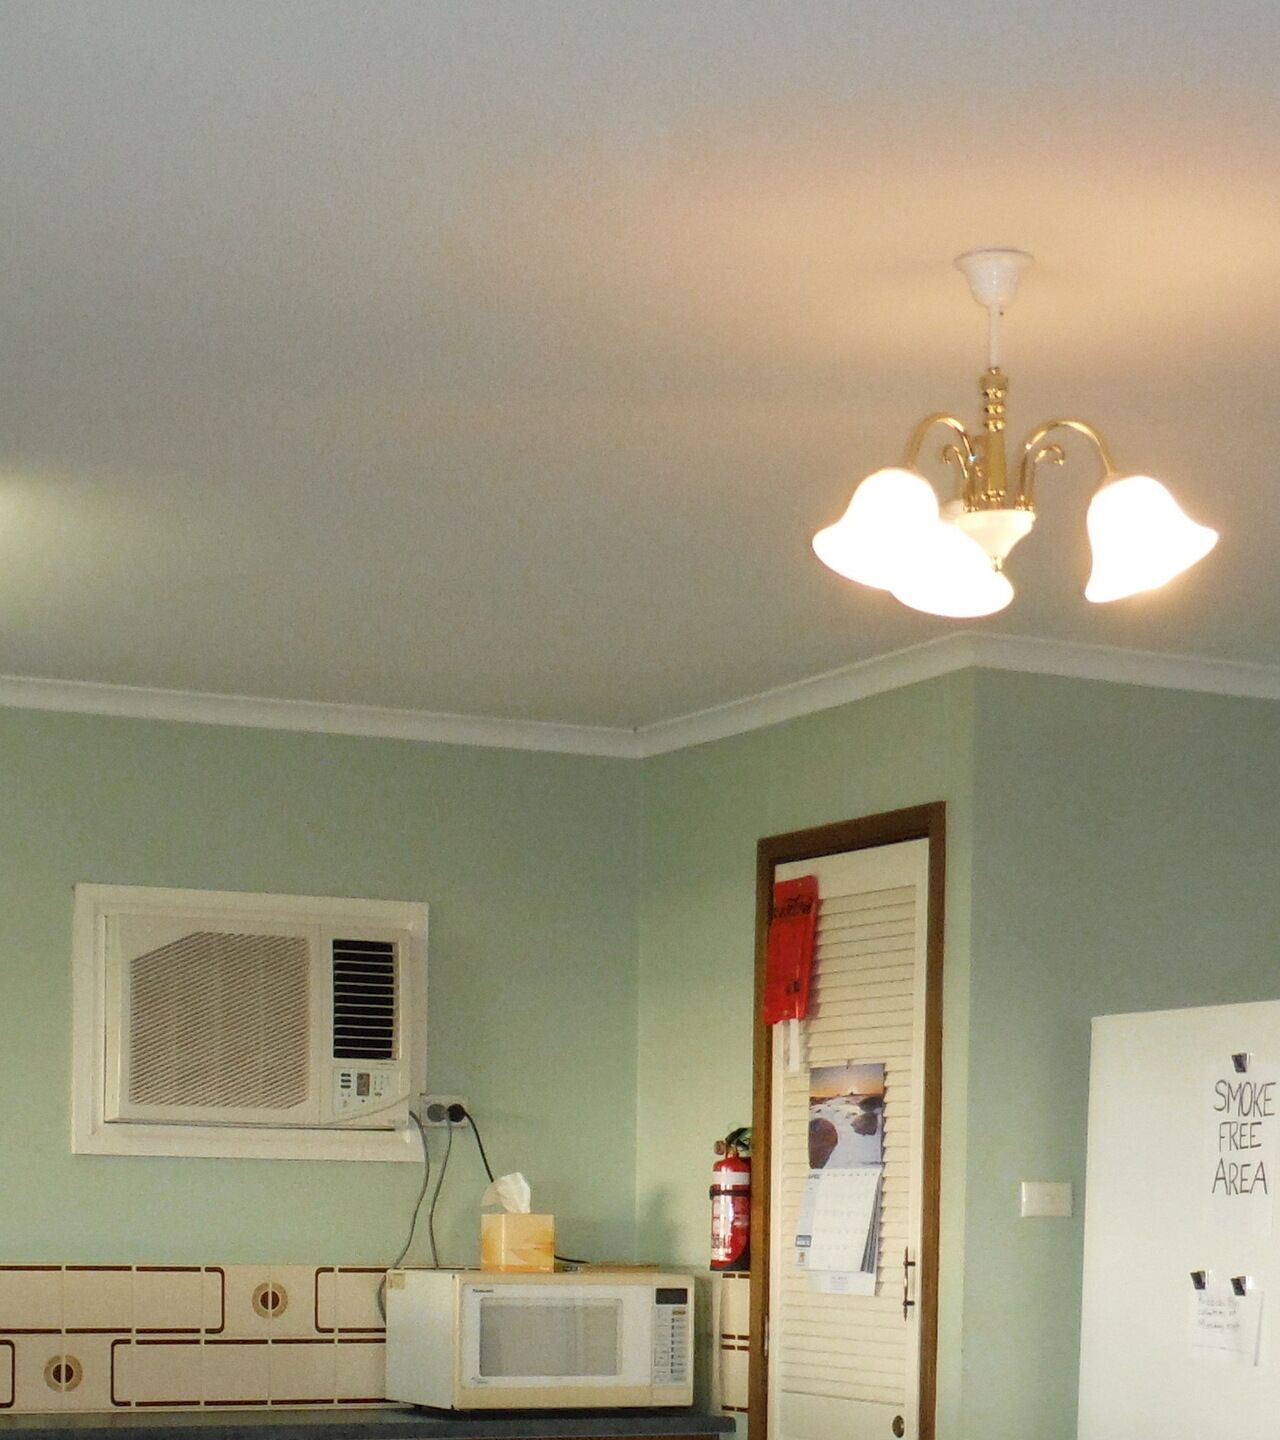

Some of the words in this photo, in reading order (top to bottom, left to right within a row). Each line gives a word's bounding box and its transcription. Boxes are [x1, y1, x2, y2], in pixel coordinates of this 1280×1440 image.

[1213, 1079, 1277, 1118] SMOKE
[1219, 1121, 1262, 1152] FREE
[1211, 1157, 1268, 1195] AREA
